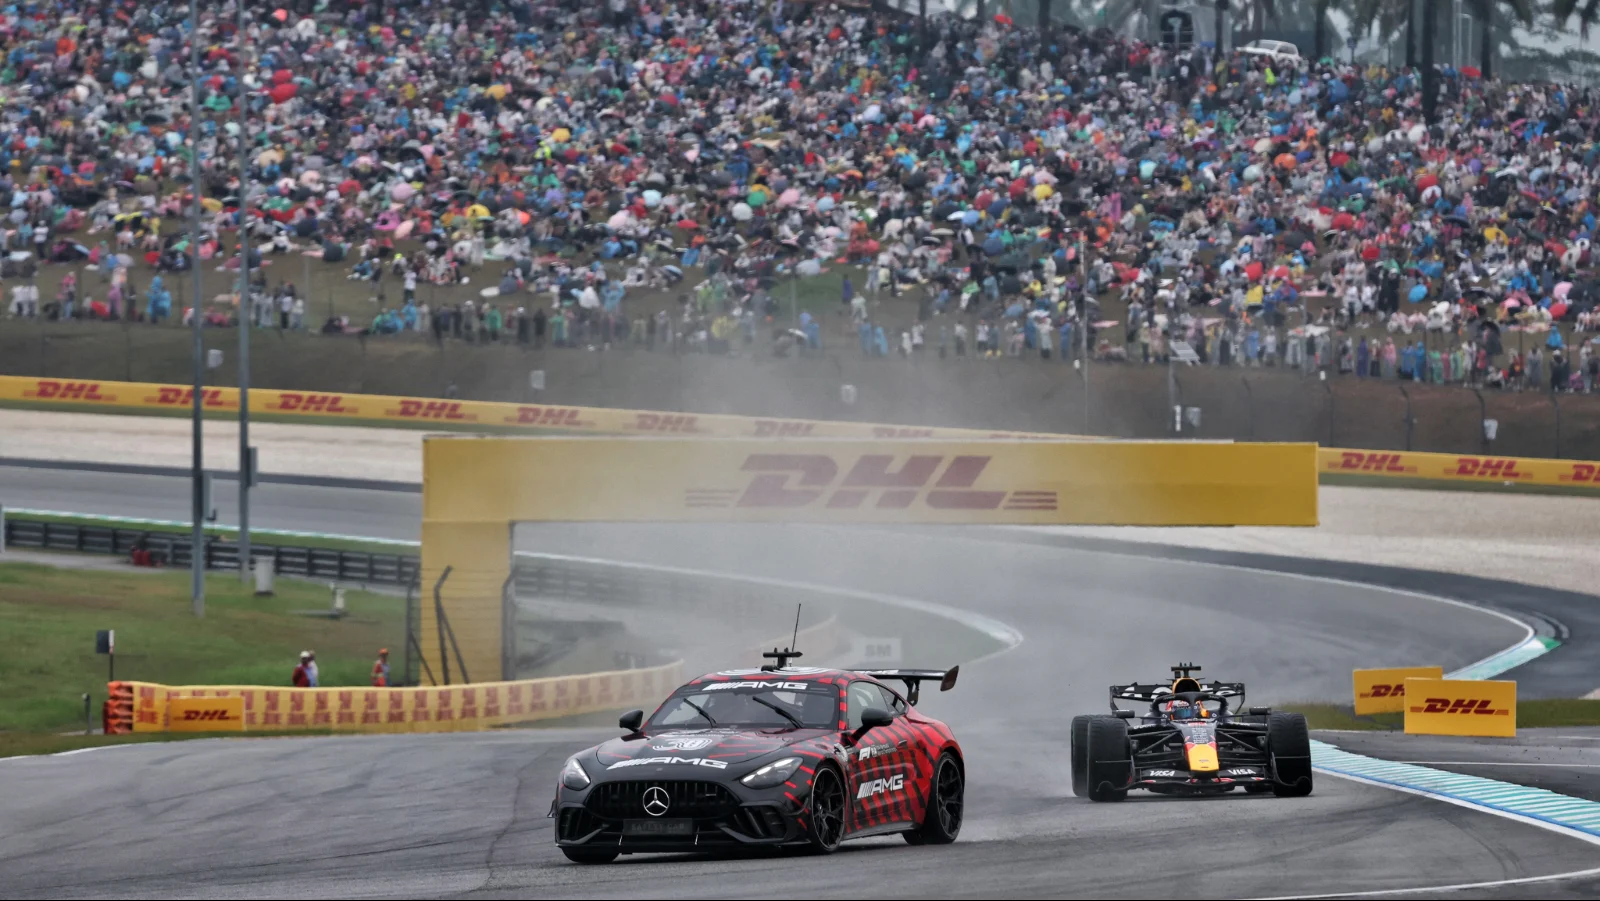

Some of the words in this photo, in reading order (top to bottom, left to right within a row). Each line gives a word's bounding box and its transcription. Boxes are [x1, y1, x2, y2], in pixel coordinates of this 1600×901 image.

[36, 381, 102, 400] DHL
[158, 387, 223, 406] DHL
[279, 393, 345, 412] DHL
[399, 400, 465, 420] DHL
[517, 407, 582, 426] DHL
[636, 414, 700, 433] DHL
[1341, 452, 1405, 472] DHL
[1456, 458, 1521, 478] DHL
[736, 454, 1008, 509] DHL
[732, 681, 809, 691] AMG
[1371, 684, 1405, 698] DH
[184, 709, 231, 721] DHL
[1423, 698, 1496, 715] DHL
[646, 757, 728, 769] AMG
[867, 773, 904, 797] AMG
